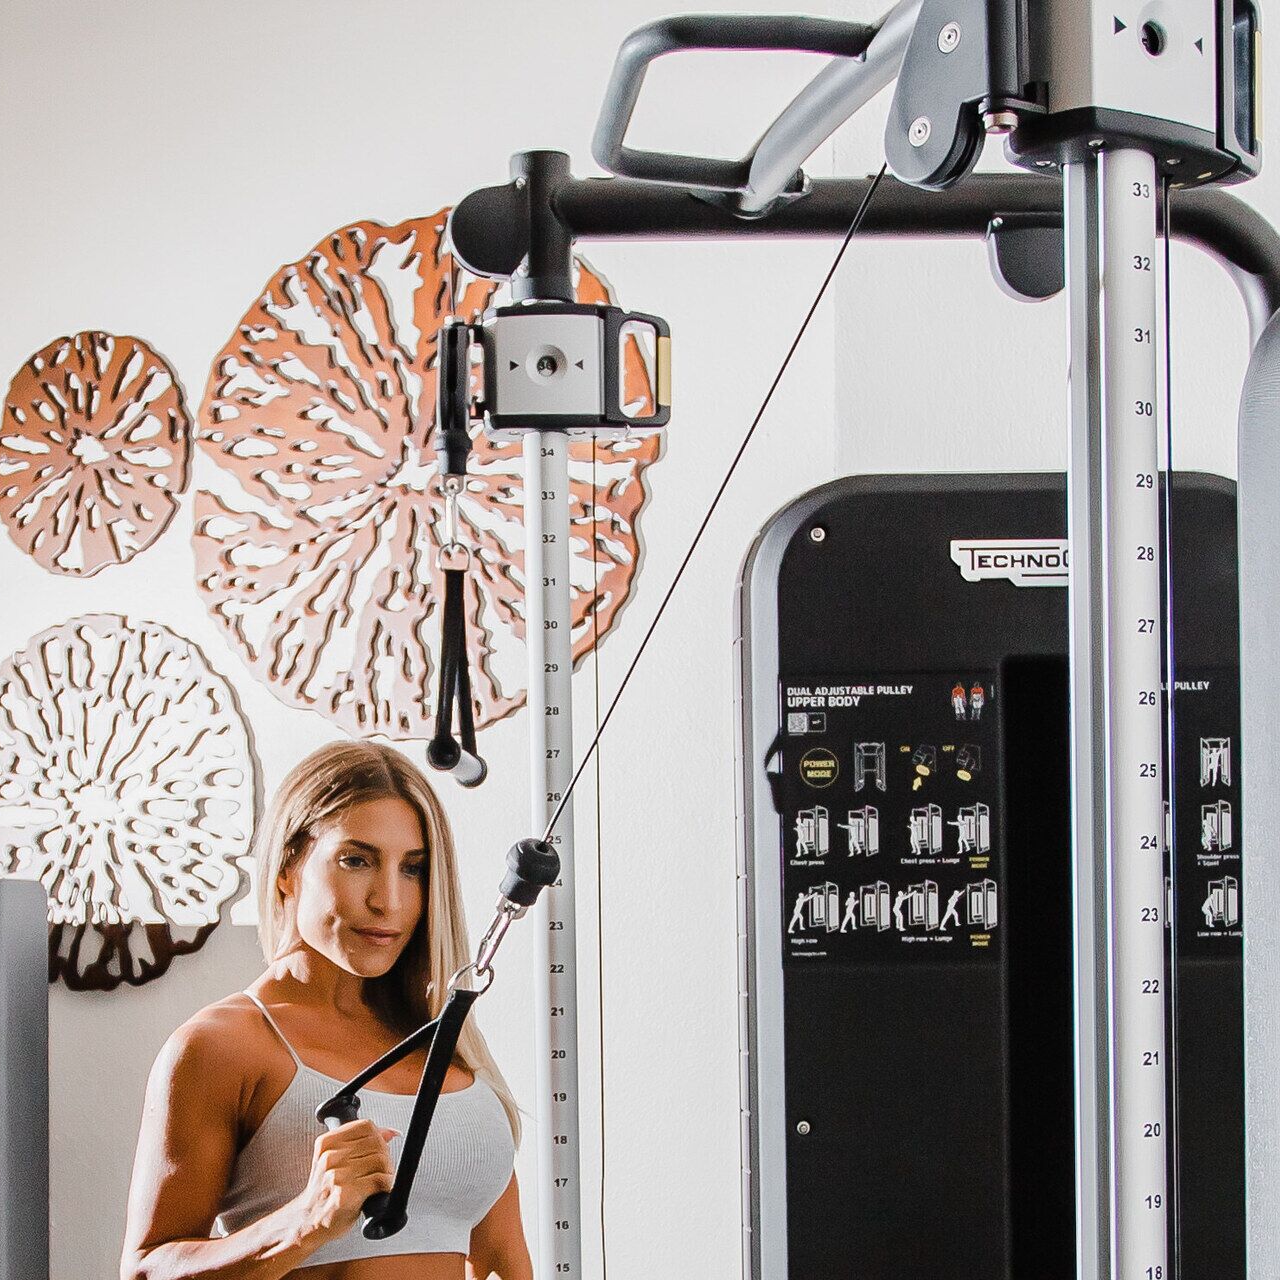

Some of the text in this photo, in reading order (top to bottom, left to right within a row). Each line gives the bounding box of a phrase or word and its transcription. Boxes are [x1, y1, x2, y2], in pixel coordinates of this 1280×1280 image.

[1132, 182, 1150, 199] 33
[1133, 255, 1151, 272] 32
[1134, 328, 1150, 344] 31
[1135, 400, 1153, 417] 30
[541, 447, 555, 457] 34
[1136, 473, 1153, 489] 29
[541, 490, 556, 501] 33
[542, 534, 556, 544] 32
[1136, 546, 1155, 562] 28
[542, 577, 556, 587] 31
[544, 620, 558, 630] 30
[1137, 618, 1155, 634] 27
[544, 663, 559, 673] 29
[787, 685, 914, 696] DUAL ADJUSTABLE PULLEY
[1174, 681, 1210, 691] PULLEY
[787, 695, 861, 708] UPPER BODY
[1138, 691, 1156, 706] 26
[545, 706, 559, 716] 28
[546, 749, 561, 759] 27
[803, 760, 836, 769] POWER
[1139, 763, 1157, 778] 25
[547, 792, 562, 802] 26
[1140, 835, 1158, 850] 24
[1141, 907, 1159, 923] 23
[549, 921, 564, 931] 23
[549, 964, 564, 974] 22
[1142, 979, 1160, 994] 22
[550, 1006, 564, 1017] 21
[551, 1049, 566, 1059] 20
[1143, 1051, 1159, 1066] 21
[552, 1092, 567, 1102] 19
[1143, 1122, 1161, 1138] 20
[553, 1135, 568, 1145] 18
[553, 1177, 569, 1188] 17
[1145, 1194, 1162, 1209] 19
[555, 1220, 570, 1230] 16
[556, 1263, 570, 1273] 15
[1145, 1265, 1163, 1280] 18
